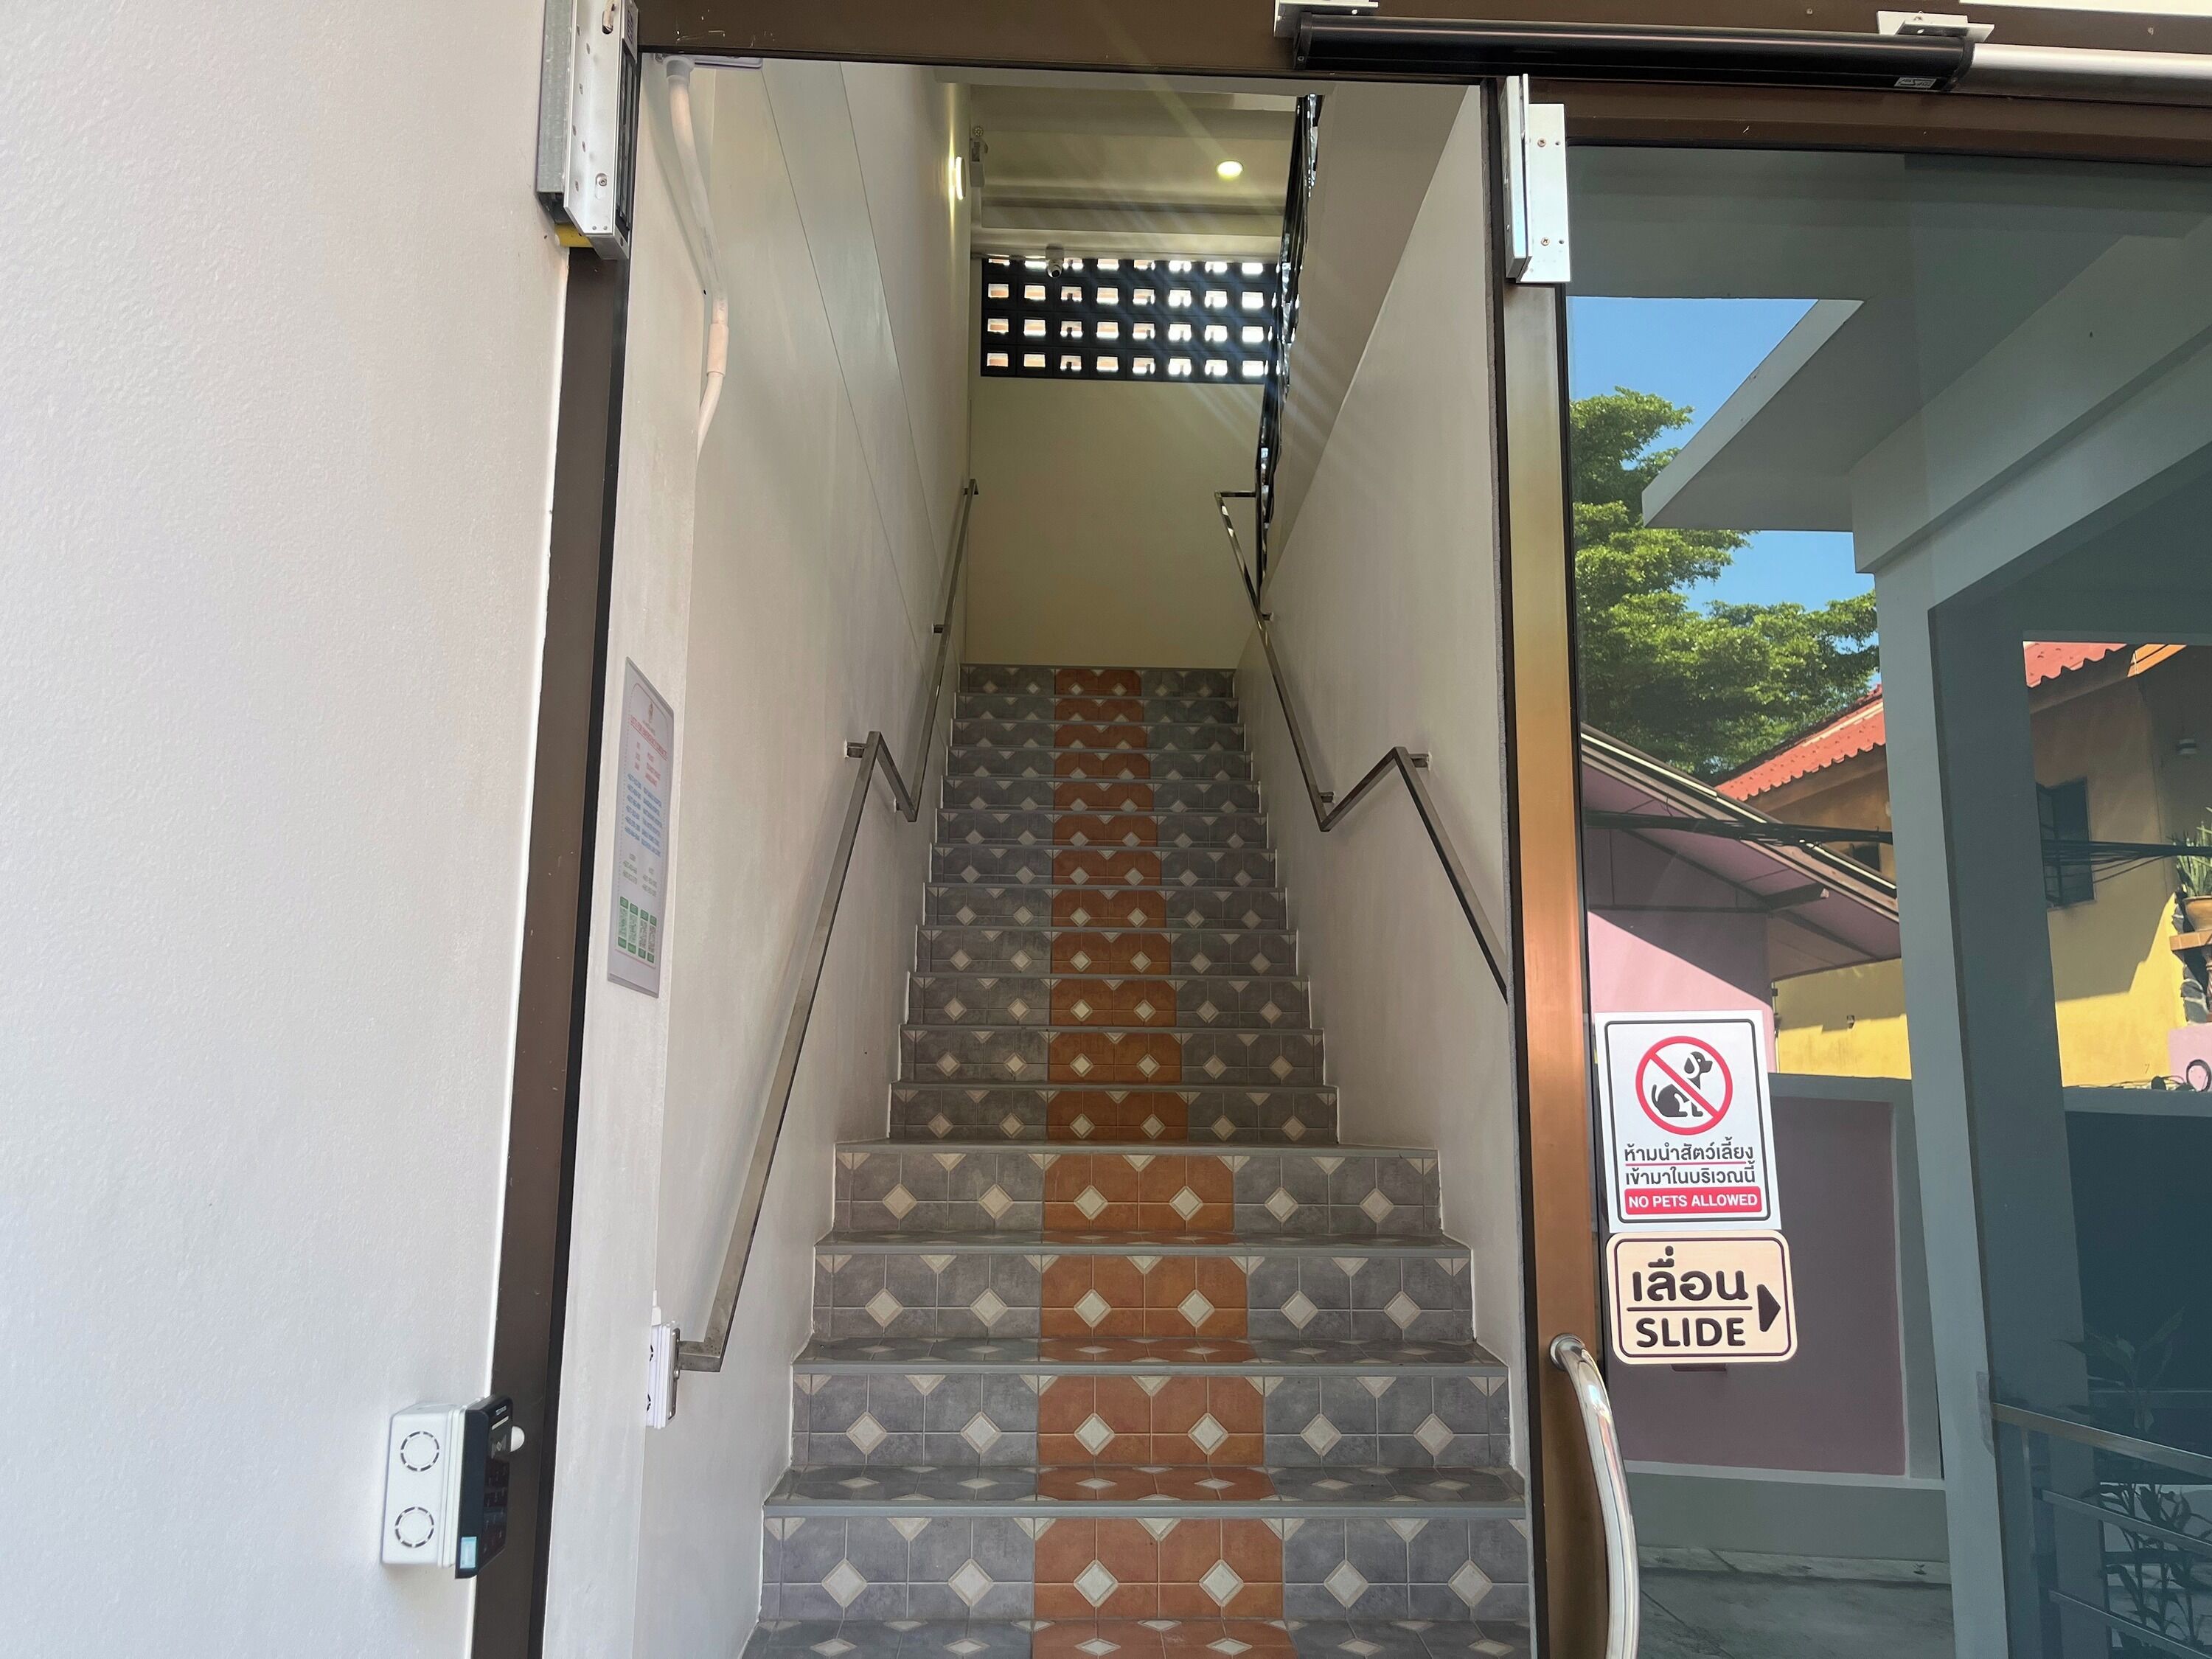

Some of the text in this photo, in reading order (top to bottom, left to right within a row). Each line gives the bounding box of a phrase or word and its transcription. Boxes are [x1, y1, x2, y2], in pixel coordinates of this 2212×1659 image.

[1624, 1136, 1754, 1161] ห้ามนำสัตว์เลี้ยง
[1625, 1160, 1756, 1185] เข้ามาในบริเวณนี้
[1628, 1193, 1758, 1208] NO PETS ALLOWED
[1632, 1245, 1749, 1301] เลื่อน
[1635, 1317, 1746, 1348] SLIDE
